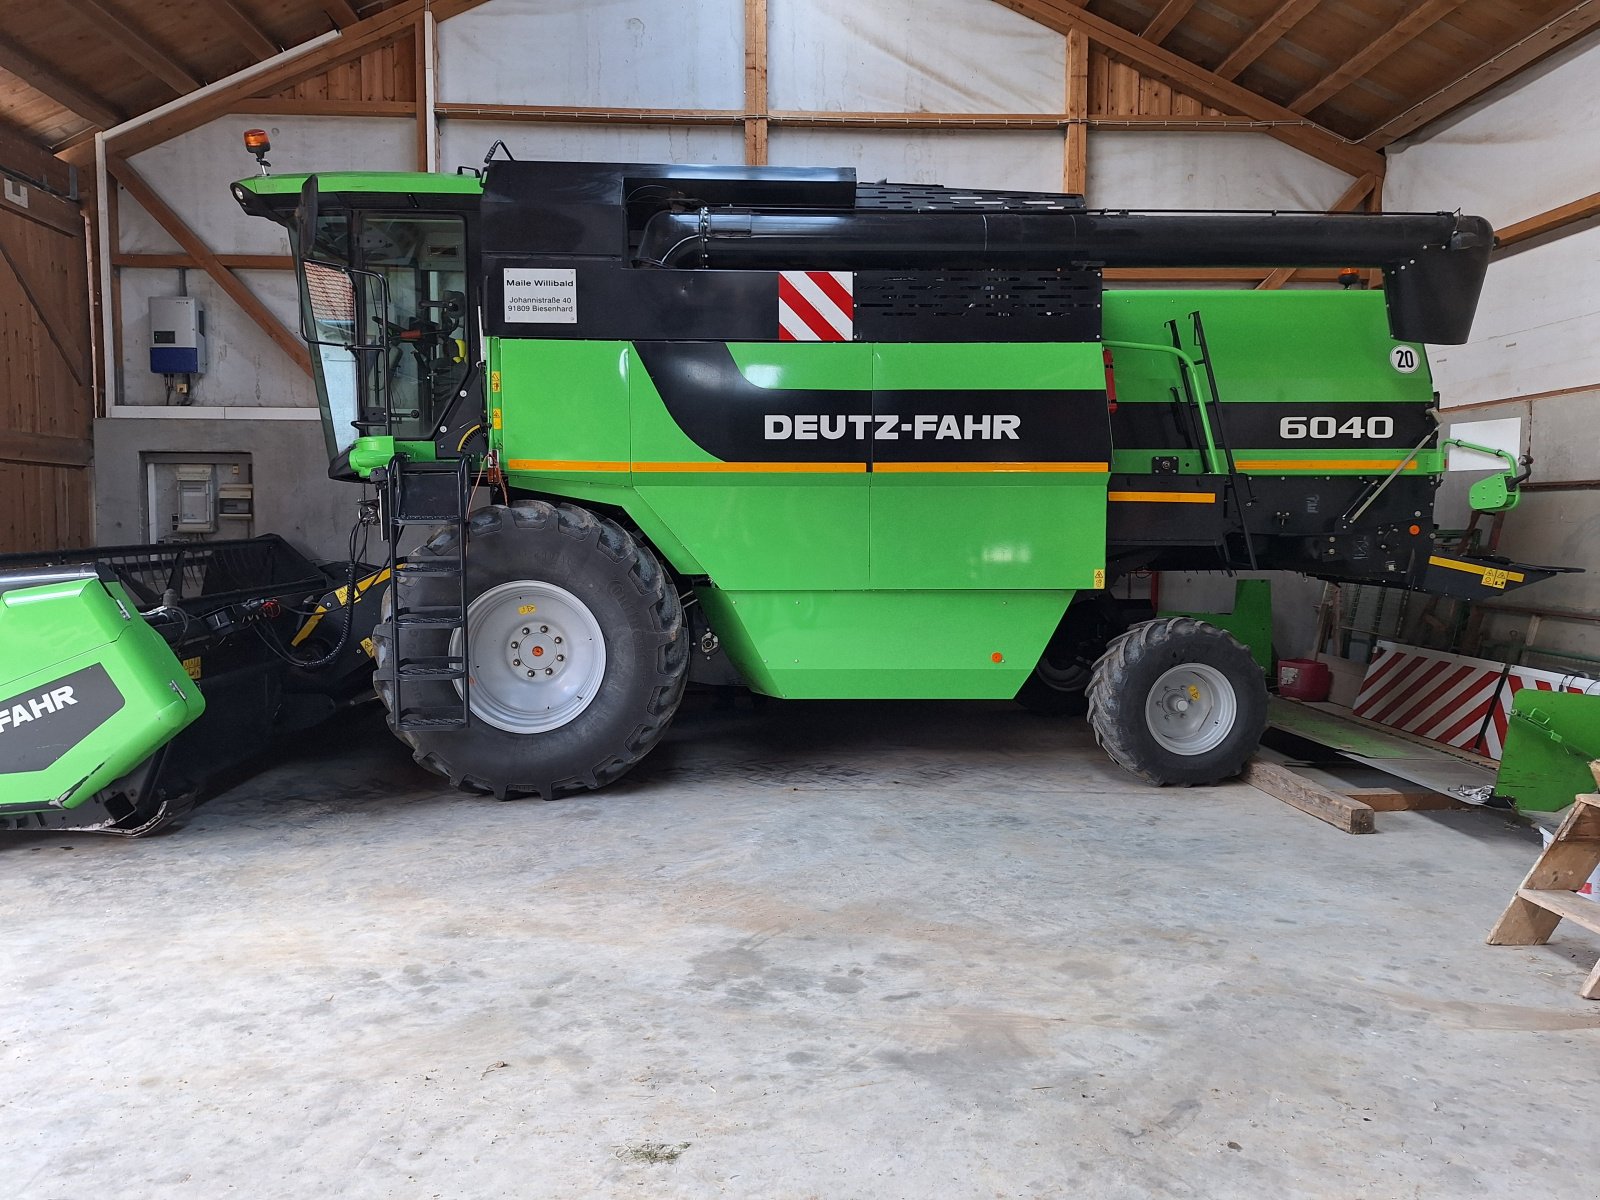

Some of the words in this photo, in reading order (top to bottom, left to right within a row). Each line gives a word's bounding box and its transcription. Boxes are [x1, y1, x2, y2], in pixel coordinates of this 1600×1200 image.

[506, 279, 532, 287] Maile
[1395, 350, 1414, 368] 20
[764, 415, 1021, 440] DEUTZ-FAHR
[1280, 416, 1394, 439] 6040
[0, 685, 79, 734] FAHR
